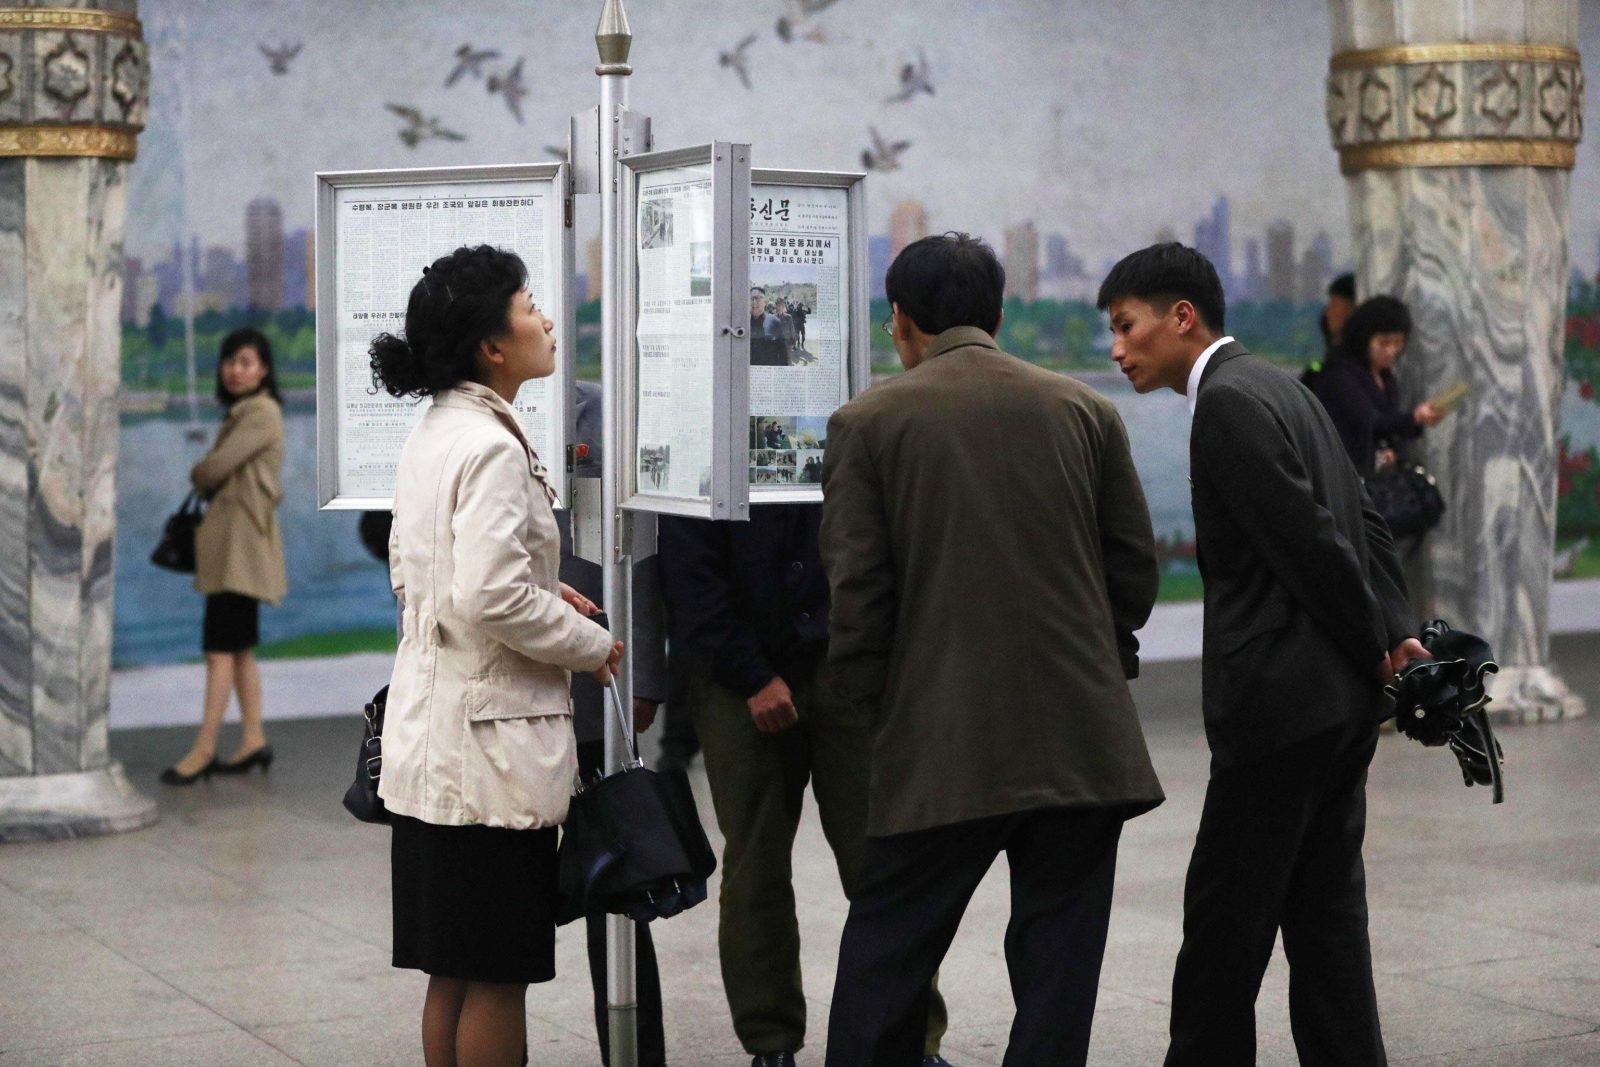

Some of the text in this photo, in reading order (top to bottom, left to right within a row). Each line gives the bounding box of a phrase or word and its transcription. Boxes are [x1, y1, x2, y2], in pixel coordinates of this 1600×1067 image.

[426, 201, 439, 209] 우리
[467, 200, 488, 208] 앞길은
[770, 238, 831, 248] 김정은동지께서
[781, 256, 824, 264] 지도하시였다
